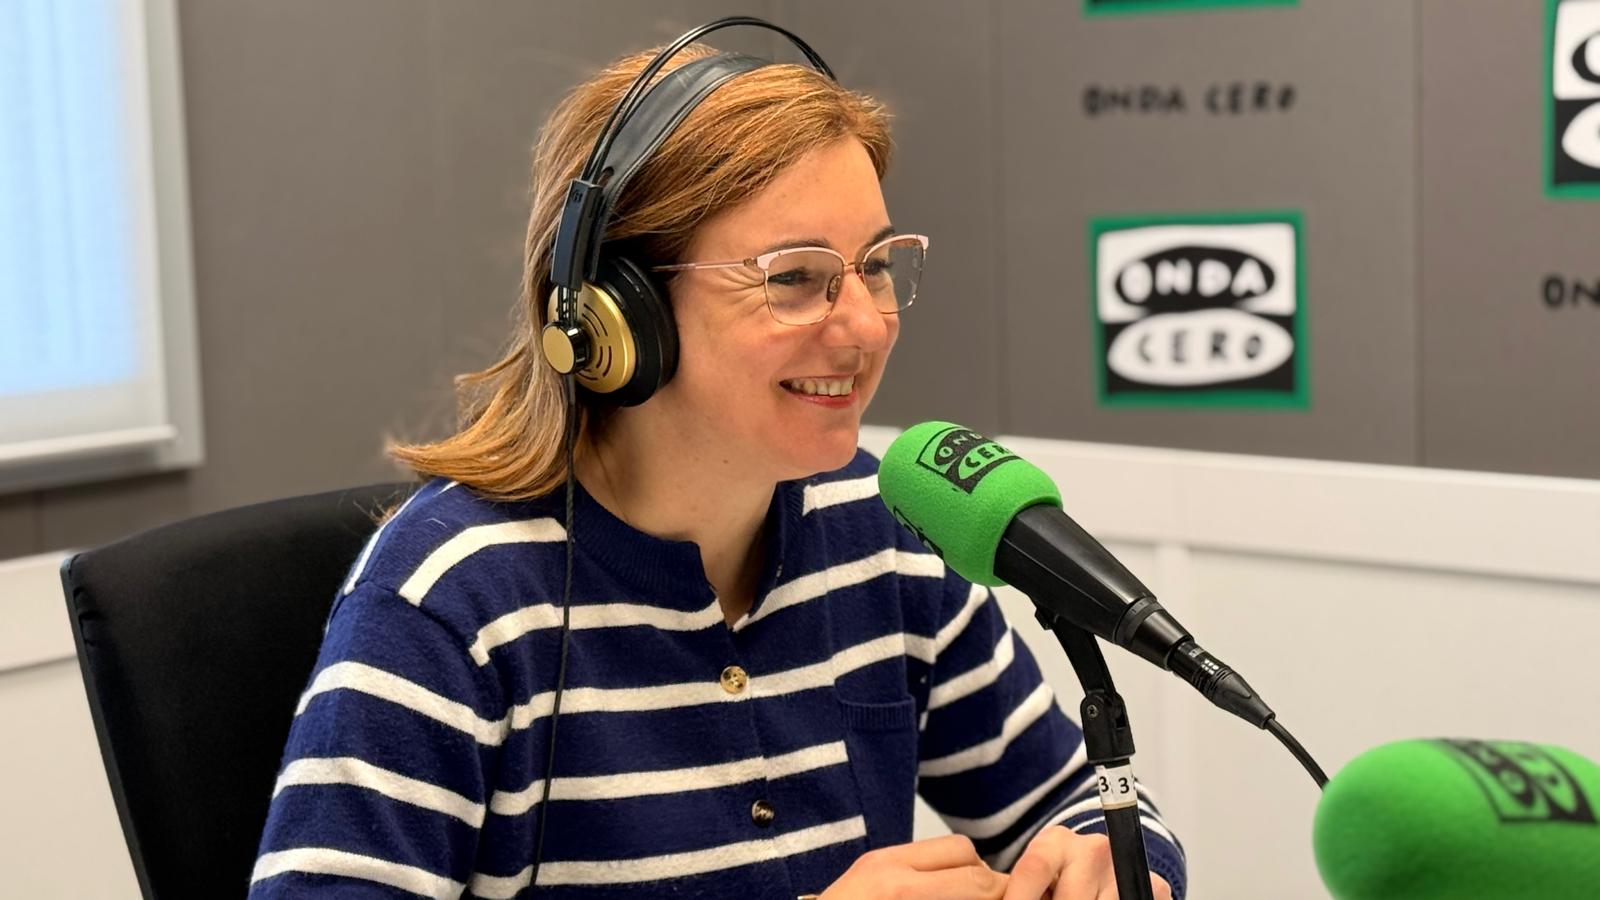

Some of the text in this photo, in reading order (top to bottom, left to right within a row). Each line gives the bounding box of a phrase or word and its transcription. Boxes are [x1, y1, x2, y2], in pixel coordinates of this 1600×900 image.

[1082, 83, 1295, 117] ONDA CERO
[1120, 258, 1268, 303] ONDA
[1137, 328, 1263, 365] CERO
[1099, 775, 1109, 793] 3
[1118, 776, 1130, 794] 3
